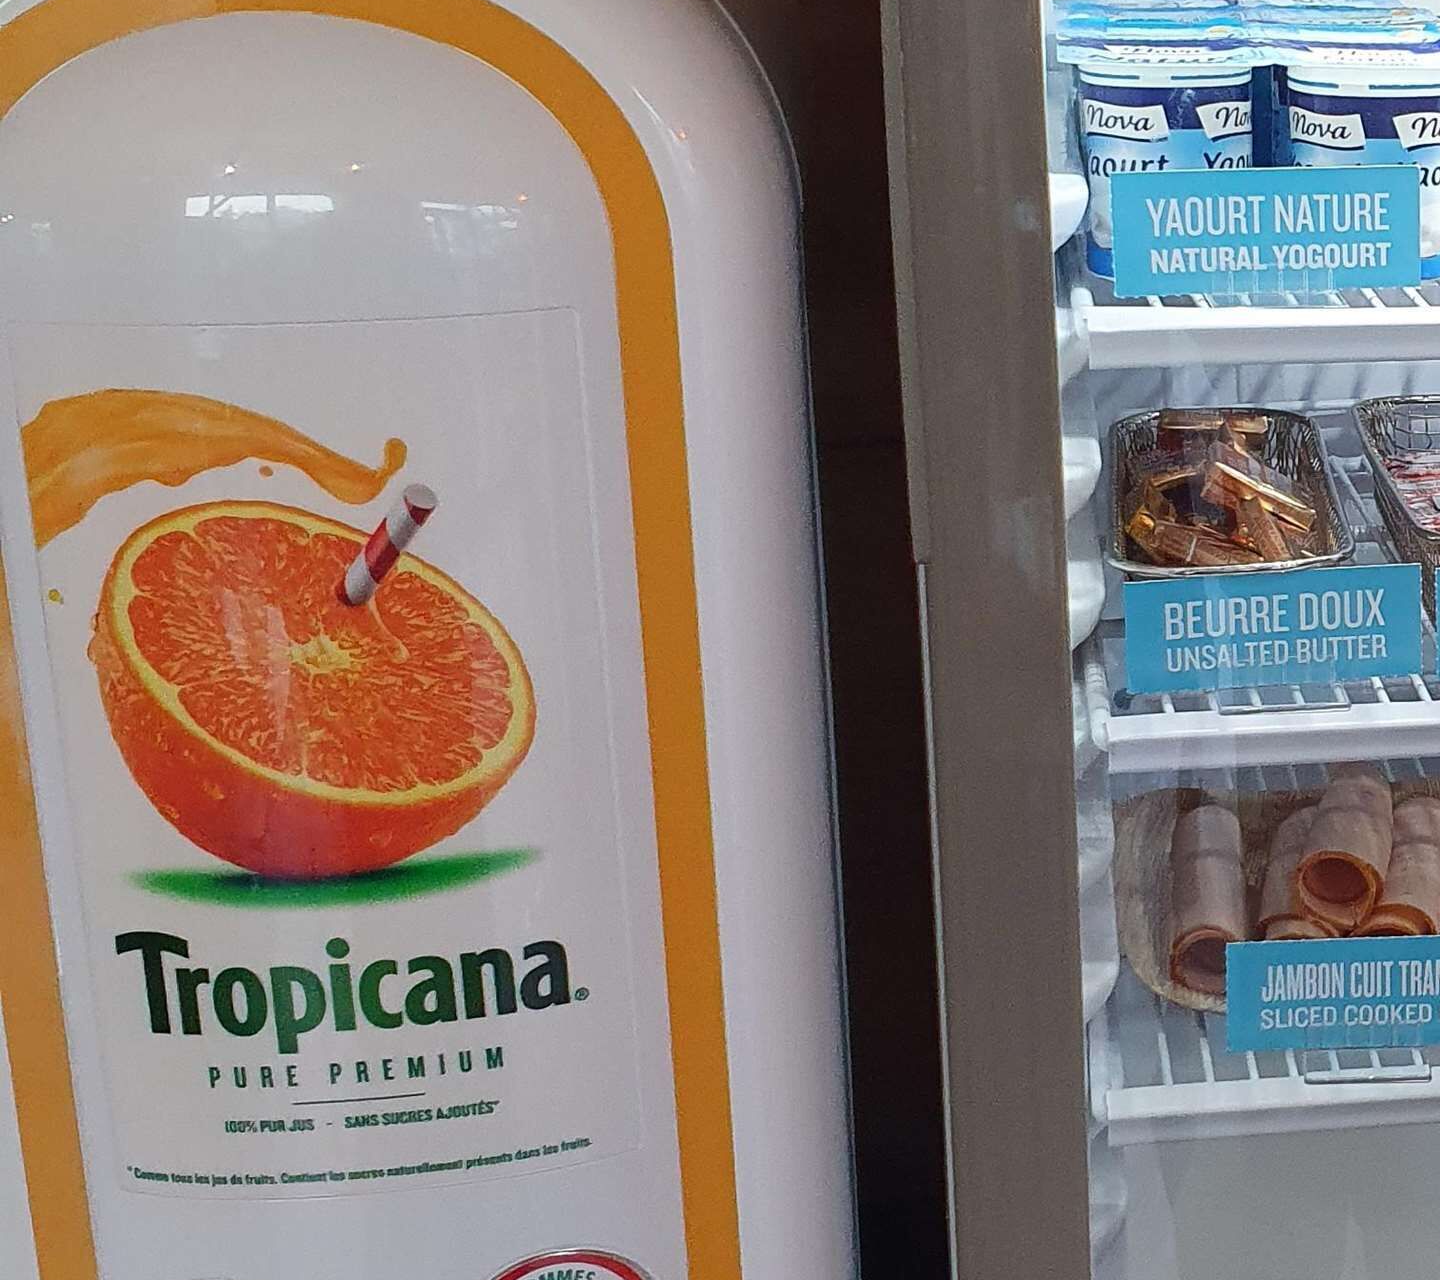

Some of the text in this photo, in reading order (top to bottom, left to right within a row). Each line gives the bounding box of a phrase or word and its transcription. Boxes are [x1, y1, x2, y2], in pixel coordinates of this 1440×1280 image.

[1086, 104, 1155, 132] Nova
[1292, 110, 1352, 140] Nova
[1088, 150, 1170, 178] aourt
[1146, 192, 1390, 237] YAOURT NATURE
[1150, 241, 1391, 274] NATURAL YOGOURT
[1164, 588, 1385, 641] BEURRE DOUX
[1166, 634, 1388, 672] UNSALTED BUTTER
[114, 930, 572, 1055] Tropicana
[1261, 962, 1346, 1003] JAMBON
[1350, 960, 1394, 998] CUIT
[1260, 1005, 1338, 1031] SLICED
[1344, 1002, 1433, 1026] COOKED
[207, 1046, 505, 1089] PURE PREMIUM
[224, 1119, 258, 1134] 100%
[287, 1118, 315, 1132] JUS
